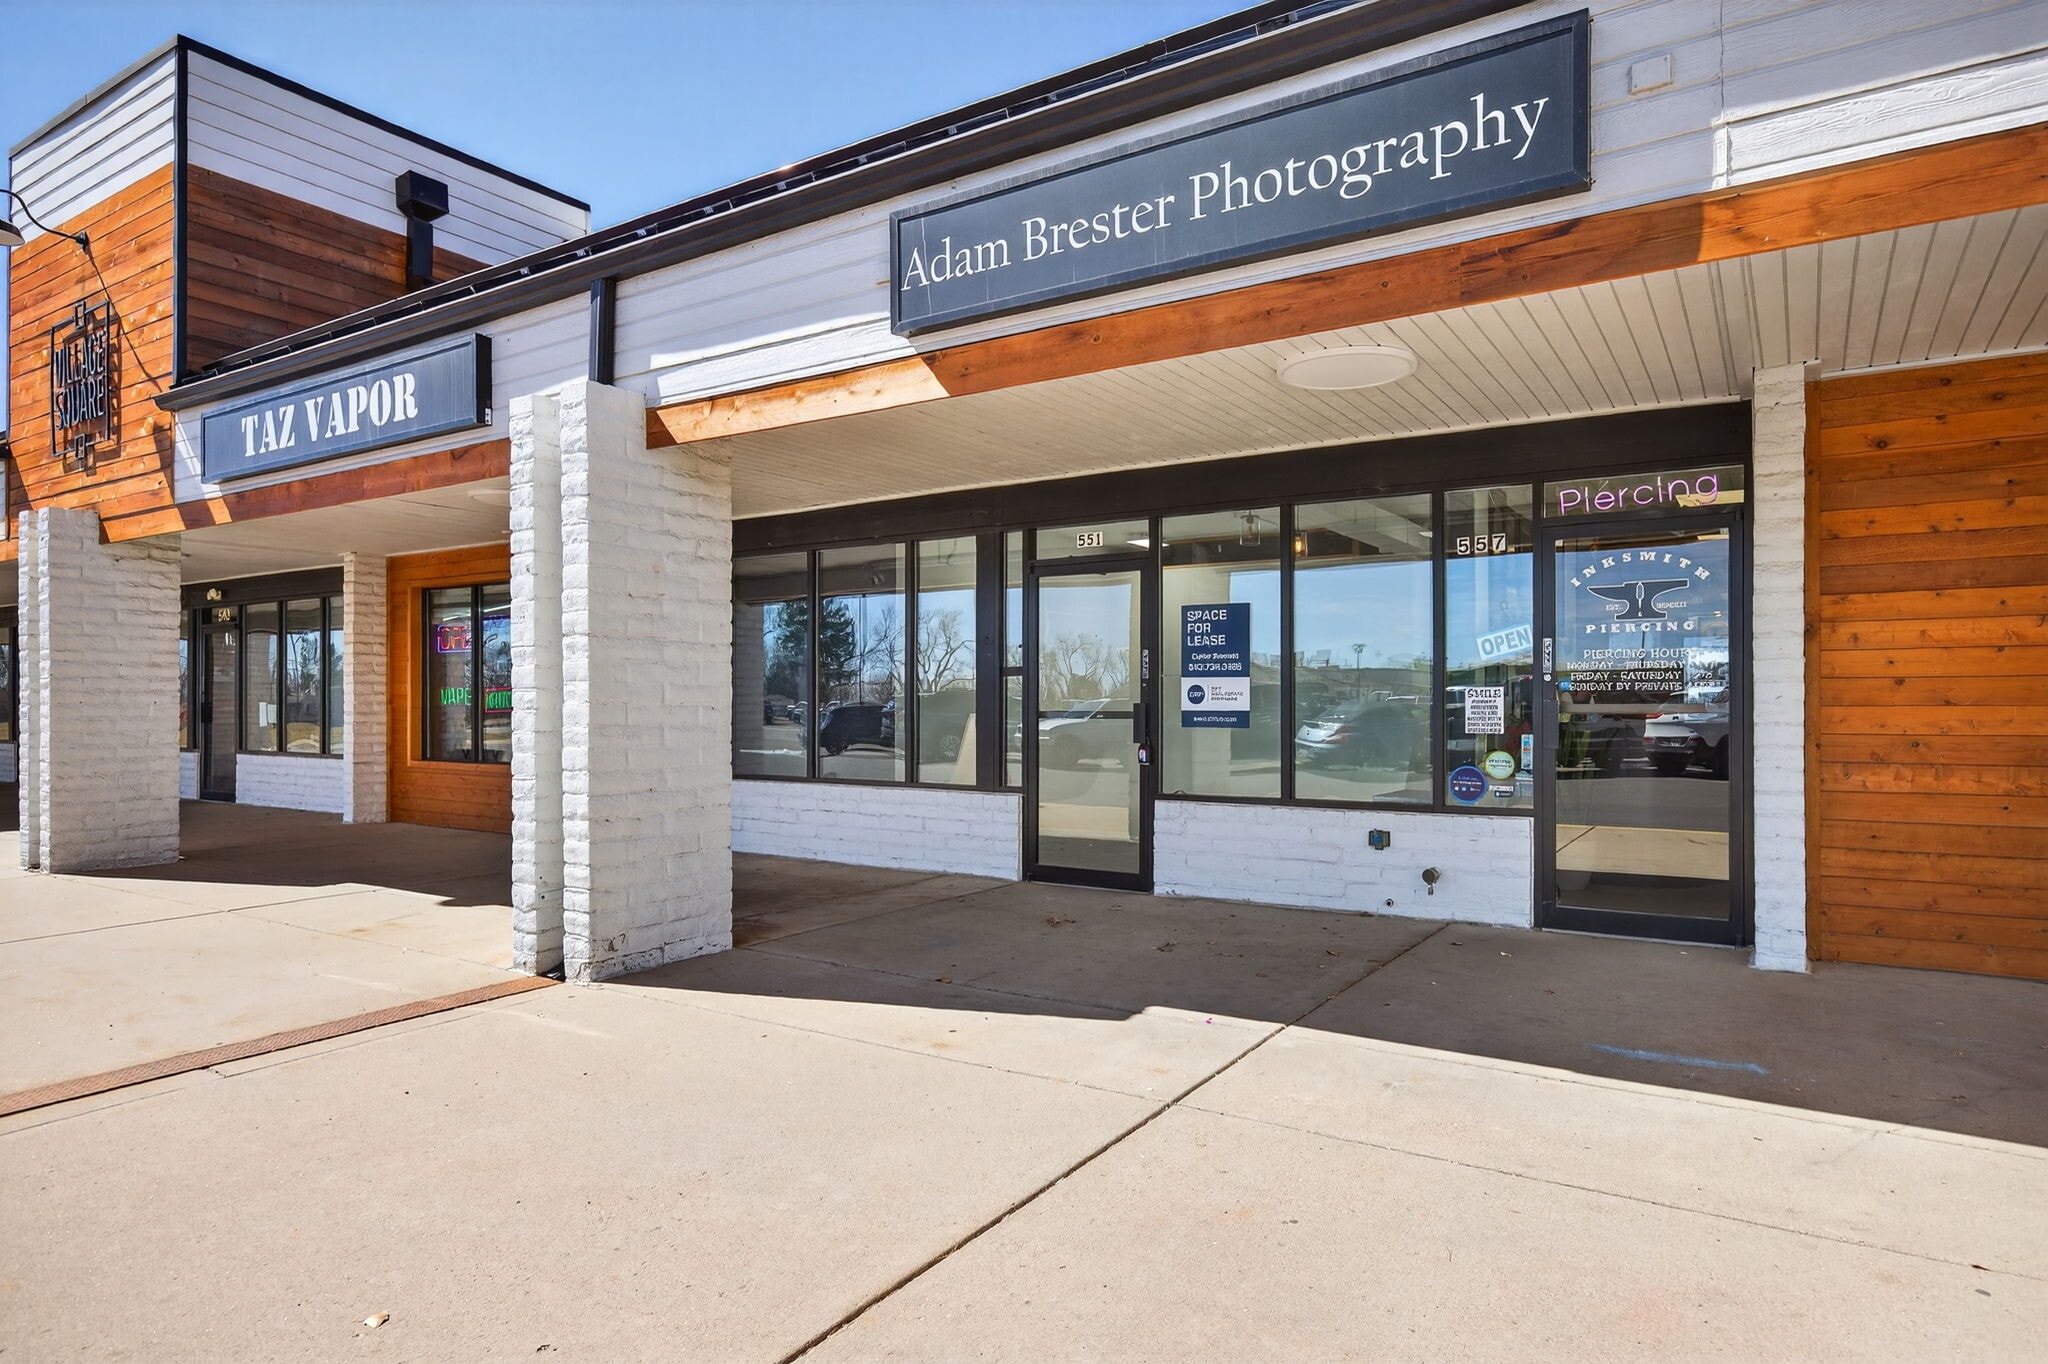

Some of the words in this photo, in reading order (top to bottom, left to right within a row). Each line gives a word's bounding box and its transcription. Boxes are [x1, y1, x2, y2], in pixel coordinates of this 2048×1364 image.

[900, 236, 1012, 291] Adam
[1021, 194, 1175, 262] Brester
[1188, 92, 1550, 222] Photography
[55, 328, 106, 388] VILLAGE
[55, 376, 106, 431] SQUARE
[241, 404, 296, 457] TAZ
[304, 372, 419, 442] VAPOR
[1078, 533, 1101, 547] 551
[1457, 533, 1506, 555] 557
[1570, 551, 1711, 588] INKSMITH
[1187, 609, 1228, 622] SPACE
[1187, 622, 1212, 634] FOR
[1585, 620, 1696, 634] PIERCING
[1187, 634, 1227, 647] LEASE
[1480, 627, 1532, 656] OPEN
